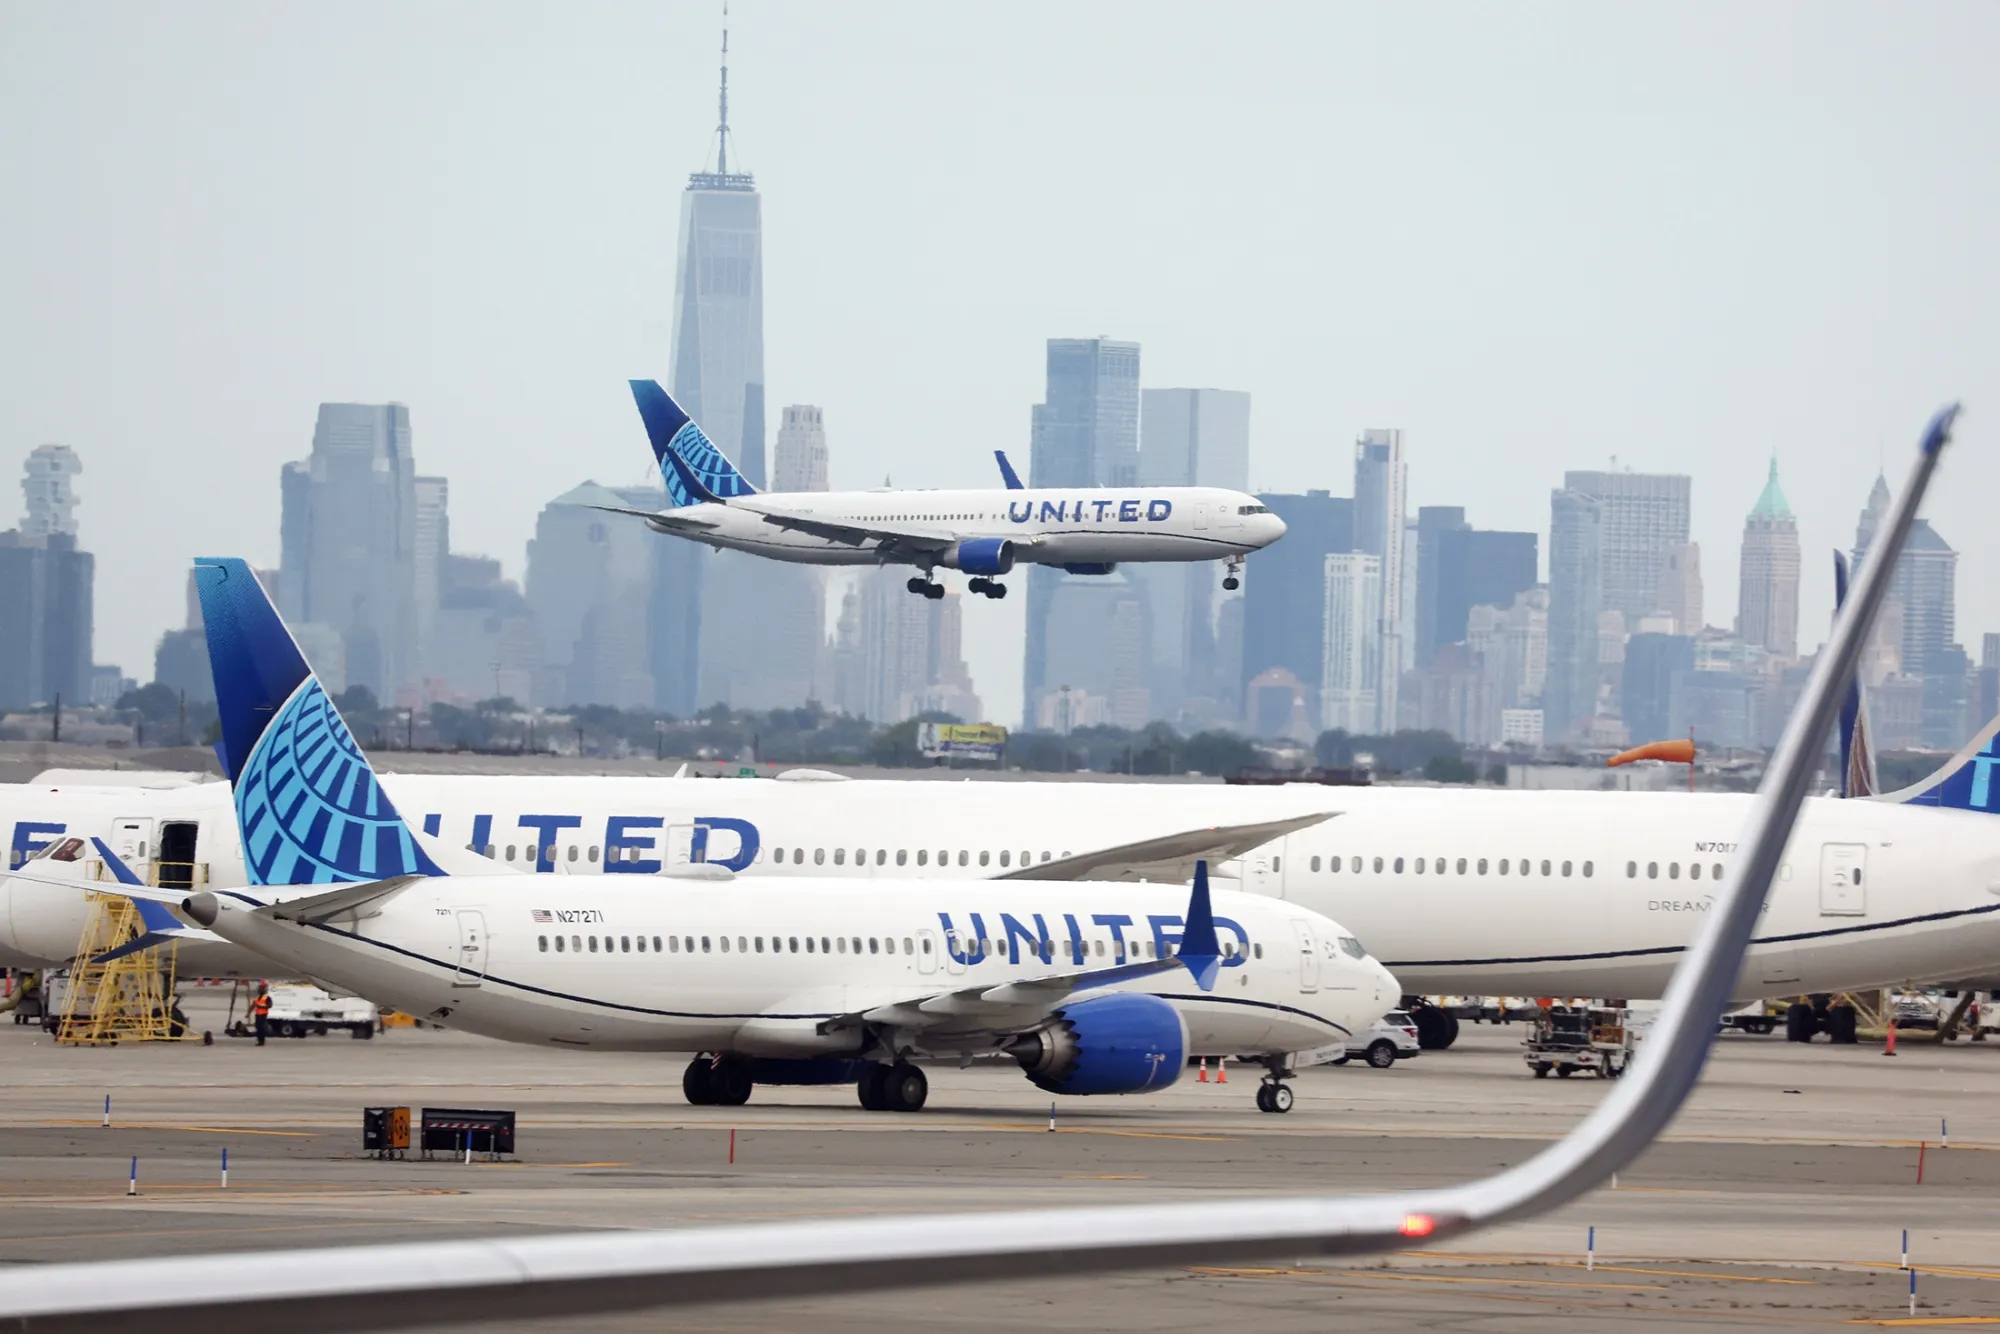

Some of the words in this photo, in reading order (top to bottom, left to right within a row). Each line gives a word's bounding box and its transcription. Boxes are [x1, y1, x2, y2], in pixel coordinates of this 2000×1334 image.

[1009, 500, 1172, 523] UNITED
[424, 814, 760, 874] ITED
[556, 910, 604, 923] N27271
